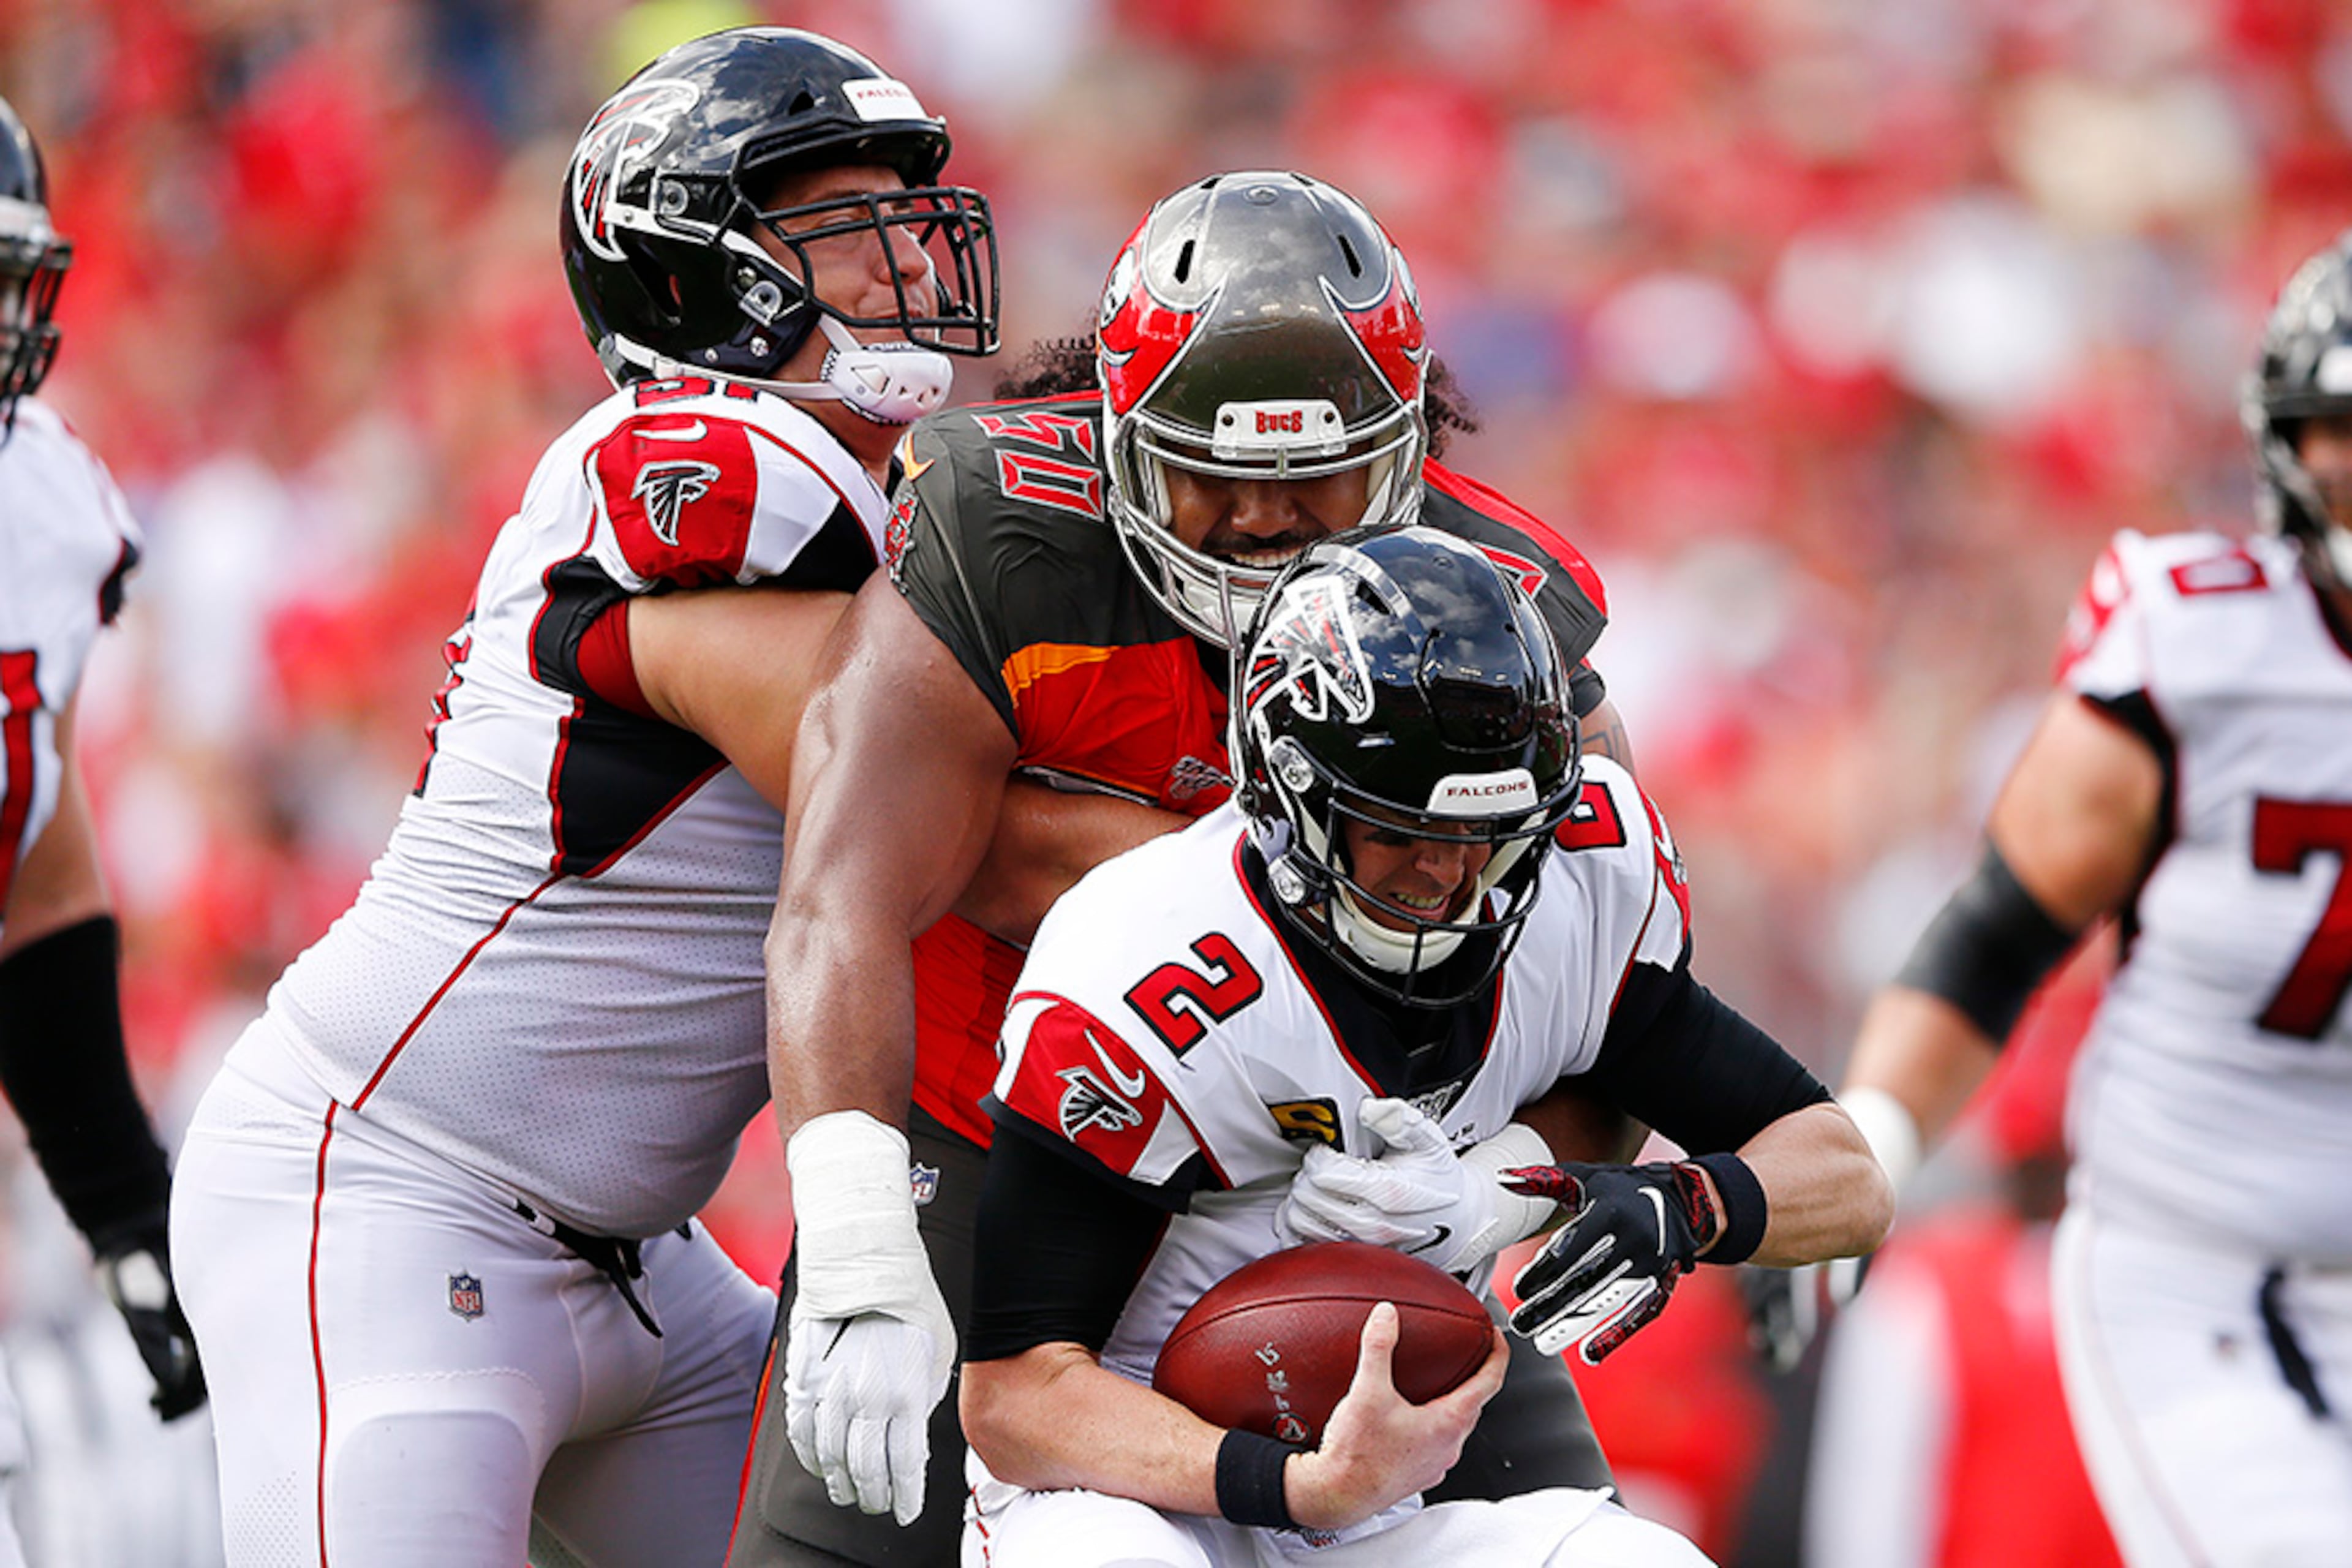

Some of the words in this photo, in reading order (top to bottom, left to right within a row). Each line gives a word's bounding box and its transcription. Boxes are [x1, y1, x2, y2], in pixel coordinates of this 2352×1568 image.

[1256, 410, 1303, 433] BUCS
[1447, 780, 1528, 796] FALCONS
[1123, 932, 1263, 1060] 2
[453, 1290, 481, 1312] NFL
